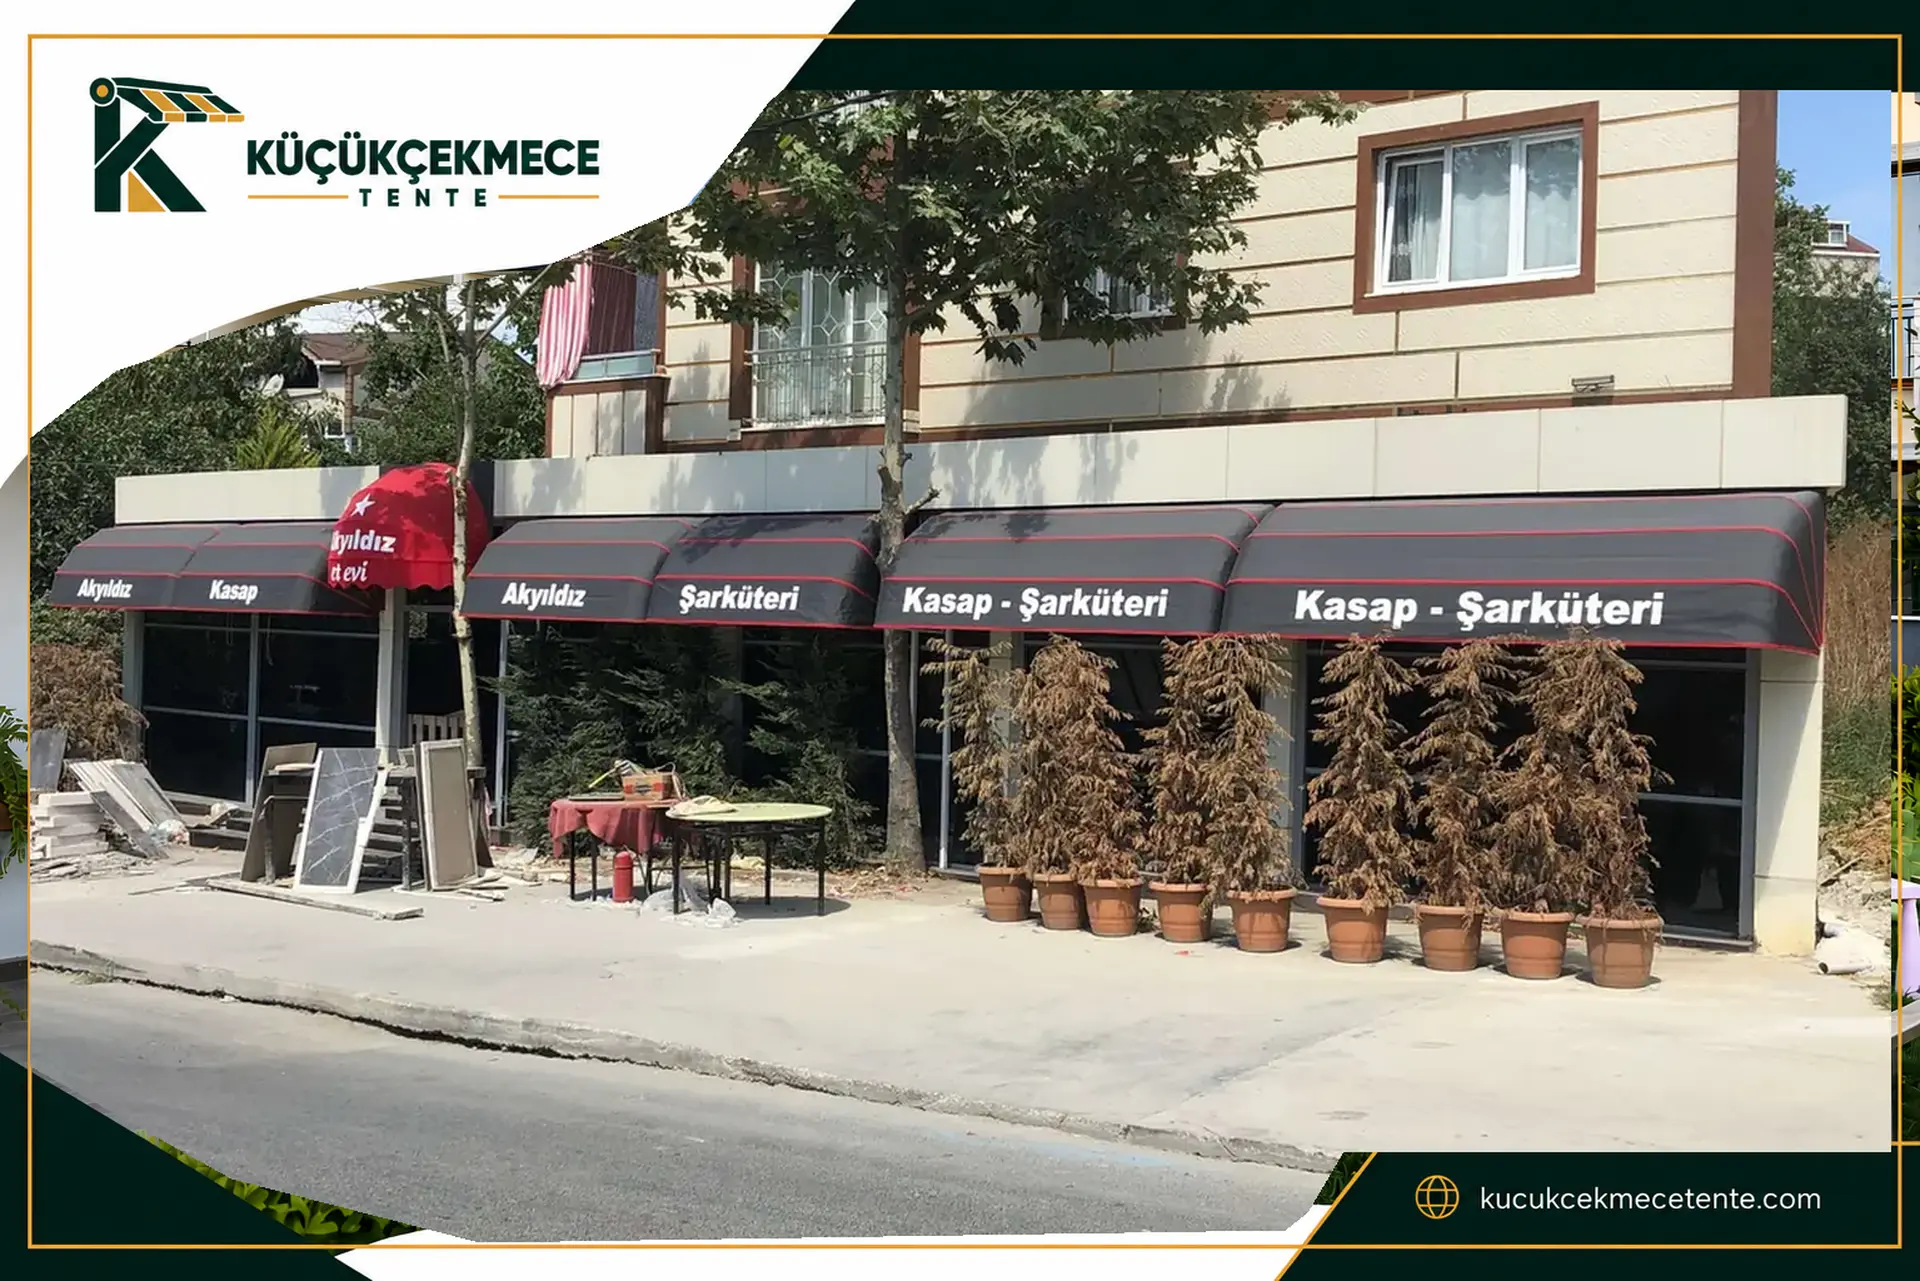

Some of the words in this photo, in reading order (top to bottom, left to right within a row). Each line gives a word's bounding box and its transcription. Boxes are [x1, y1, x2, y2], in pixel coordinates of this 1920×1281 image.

[343, 561, 369, 582] evi
[76, 578, 133, 603] Akyıldız
[209, 579, 259, 604] Kasap
[500, 582, 587, 612] Akyıldız
[679, 584, 800, 615] Şarküteri
[902, 586, 993, 621] Kasap
[1018, 587, 1169, 623] Şarküteri
[1294, 589, 1418, 629] Kasap
[1456, 590, 1665, 631] Şarküteri
